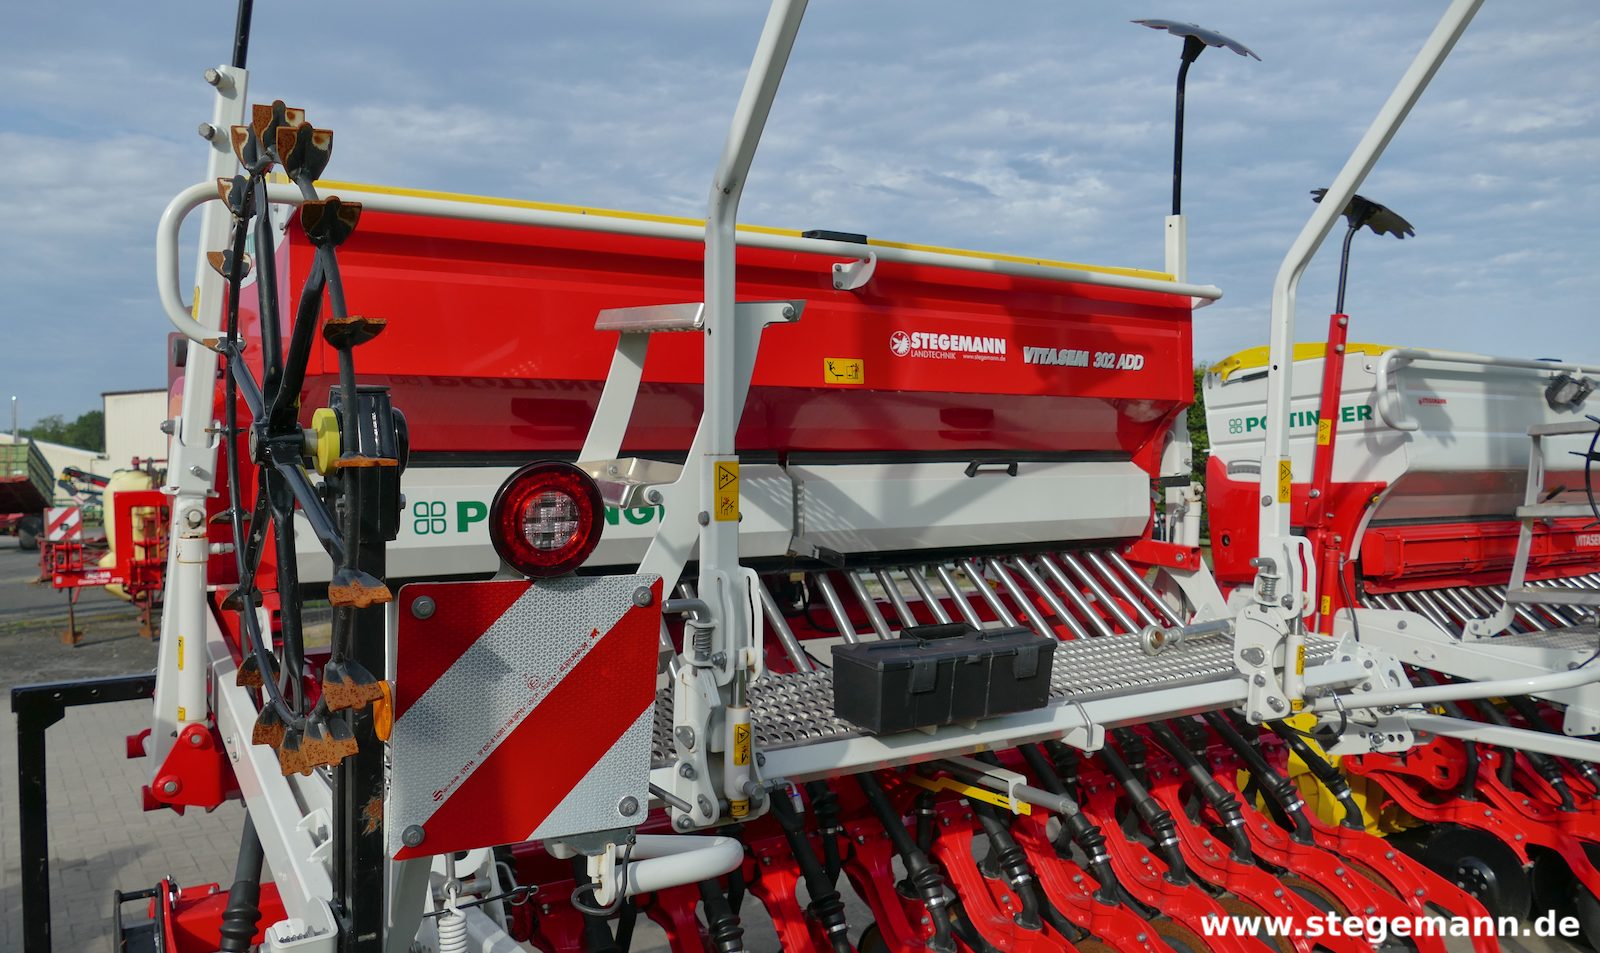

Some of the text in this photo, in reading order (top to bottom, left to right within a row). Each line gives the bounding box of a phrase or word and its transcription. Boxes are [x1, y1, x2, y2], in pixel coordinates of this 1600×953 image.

[911, 331, 1006, 355] STEGEMANN
[911, 350, 956, 360] LANDTECHNIK
[1022, 346, 1144, 371] VITASEM 302 ADD
